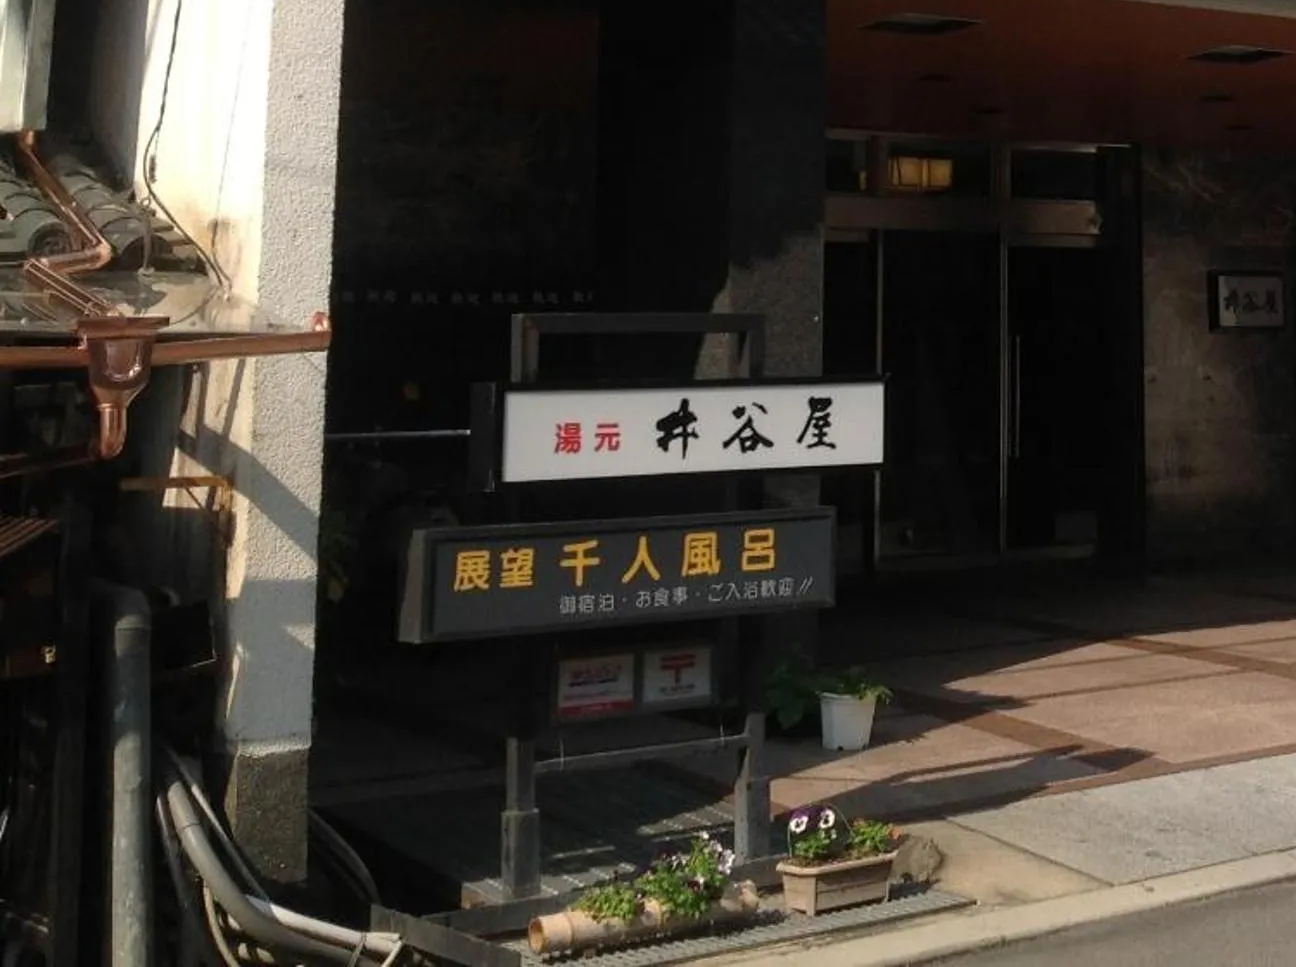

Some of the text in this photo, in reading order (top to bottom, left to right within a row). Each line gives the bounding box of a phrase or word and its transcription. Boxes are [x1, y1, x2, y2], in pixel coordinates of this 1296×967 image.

[554, 397, 837, 459] 湯元 井谷屋
[453, 527, 776, 592] 展望 千人風呂
